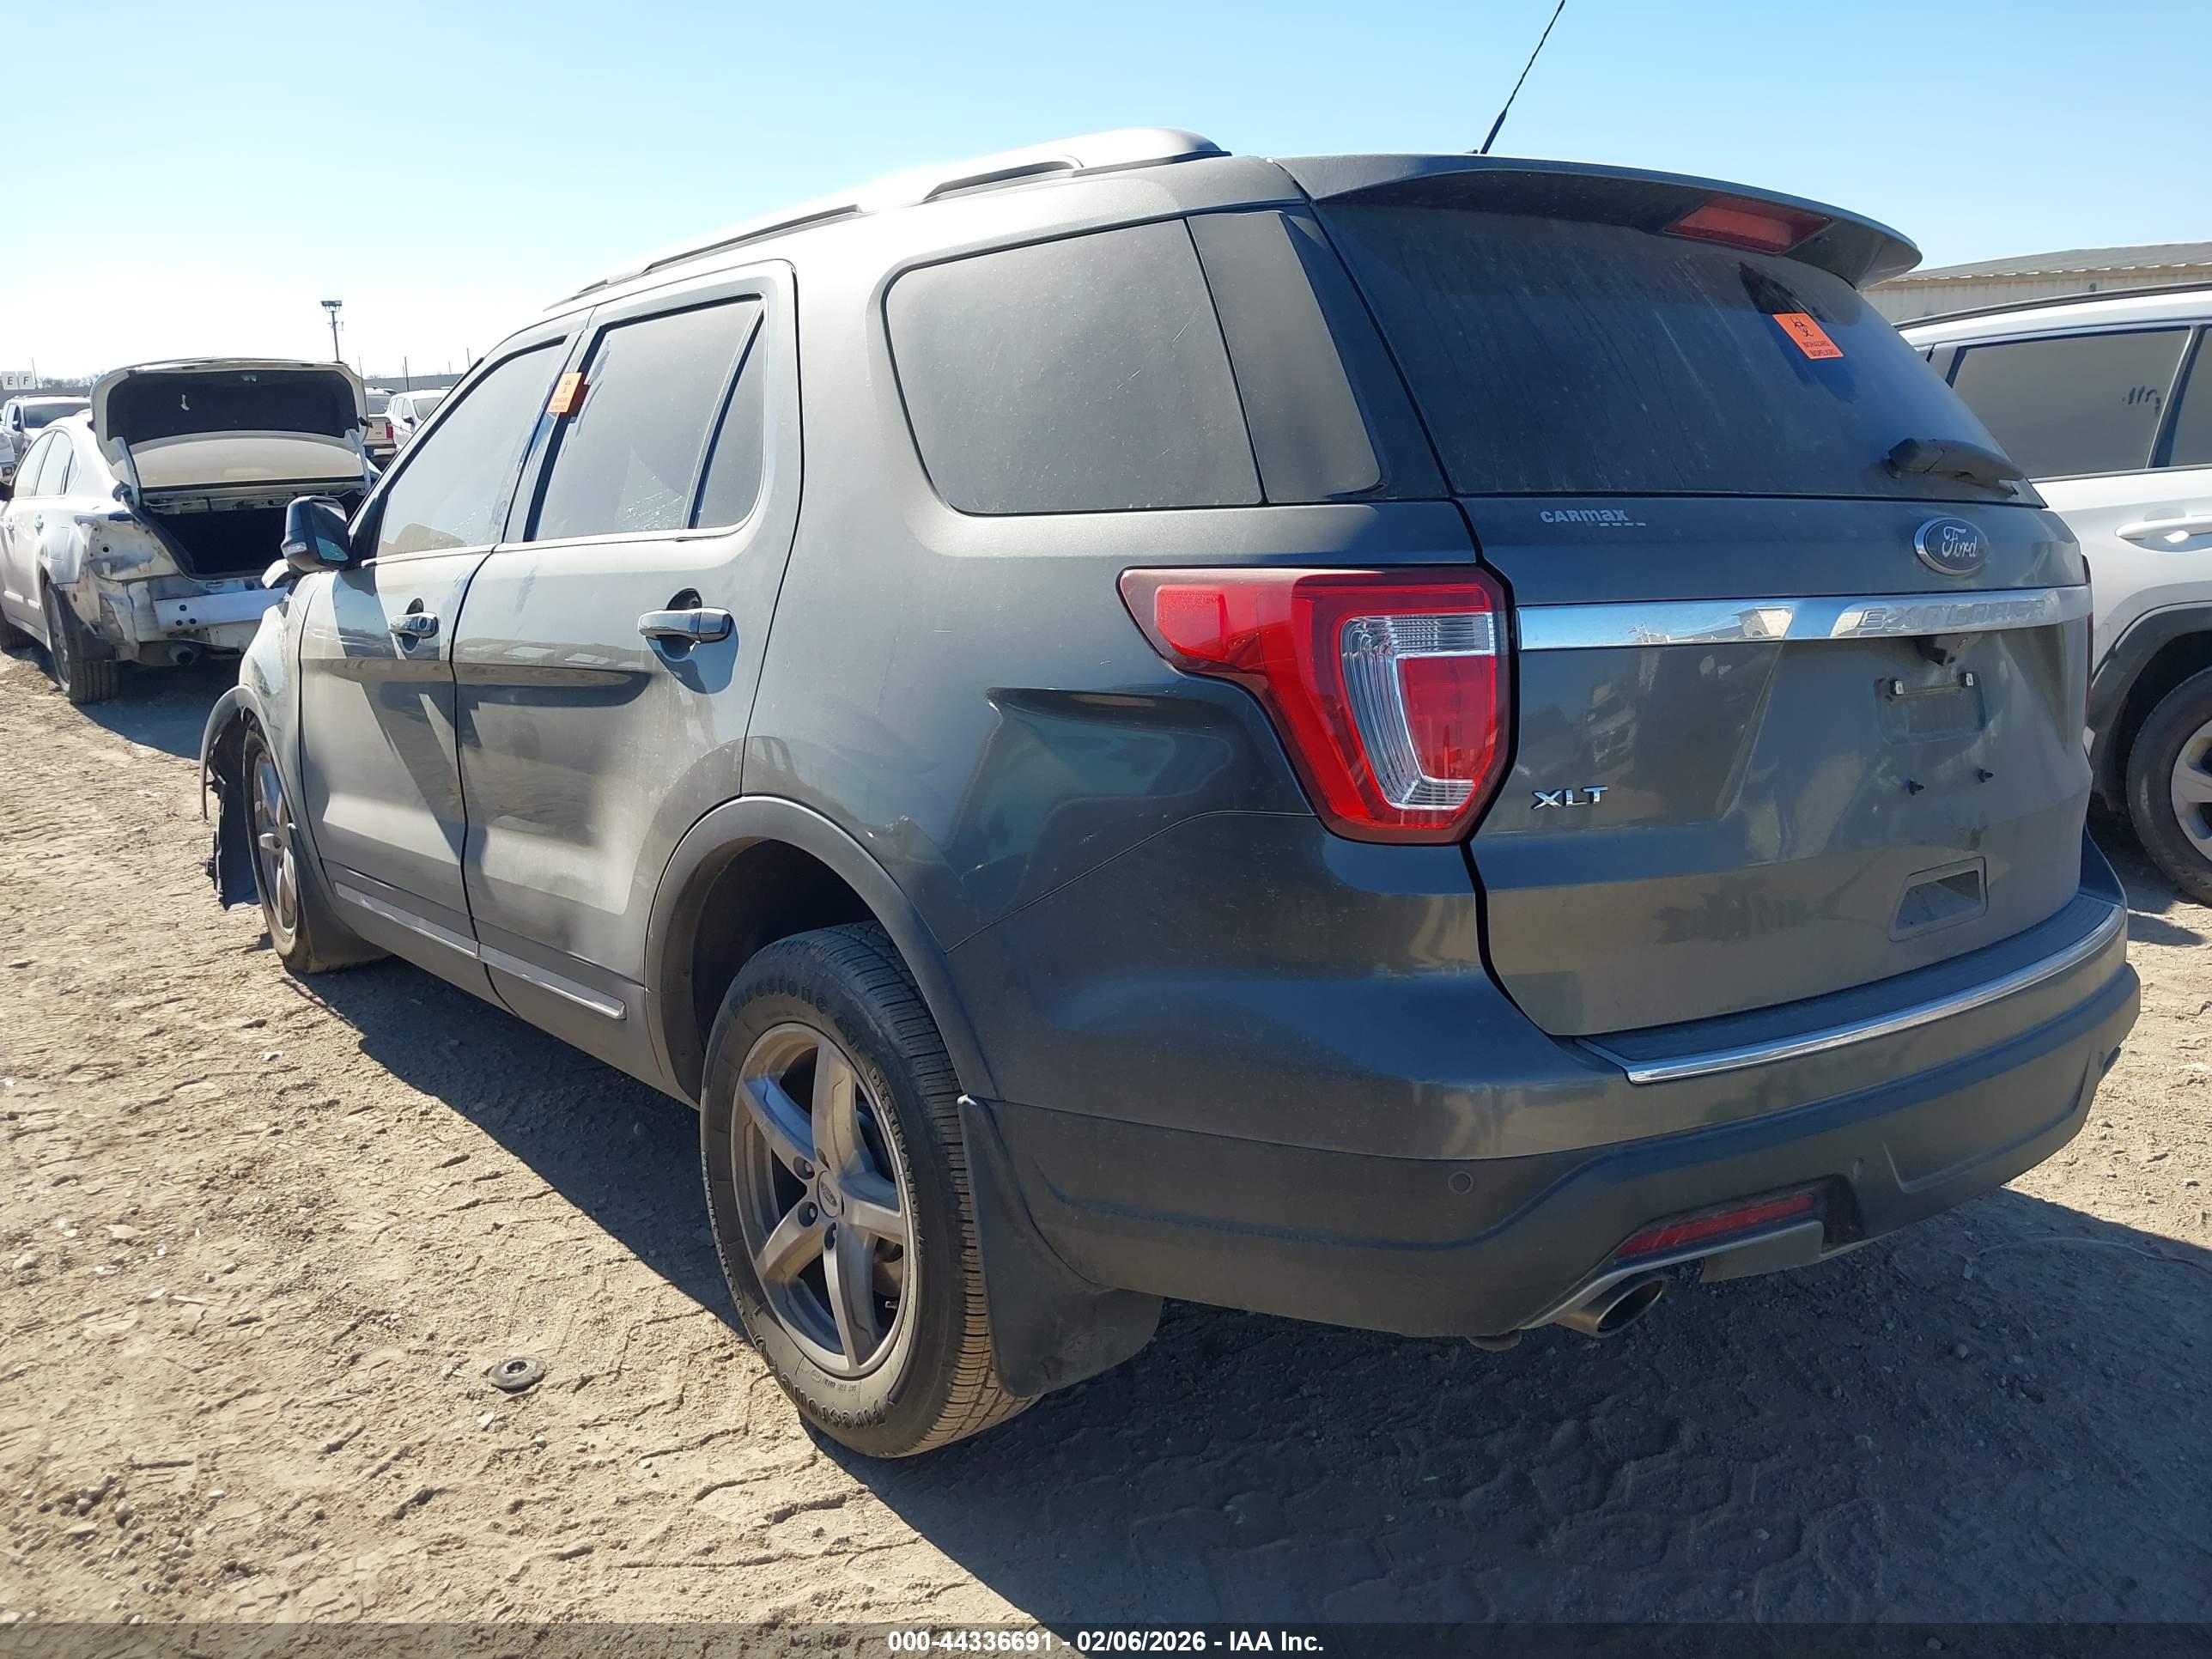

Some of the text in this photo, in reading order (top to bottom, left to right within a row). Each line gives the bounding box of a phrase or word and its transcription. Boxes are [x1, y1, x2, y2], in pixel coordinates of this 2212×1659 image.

[8, 376, 13, 385] E
[23, 376, 29, 385] F
[1942, 526, 1978, 557] Ford
[1532, 786, 1608, 810] XLT
